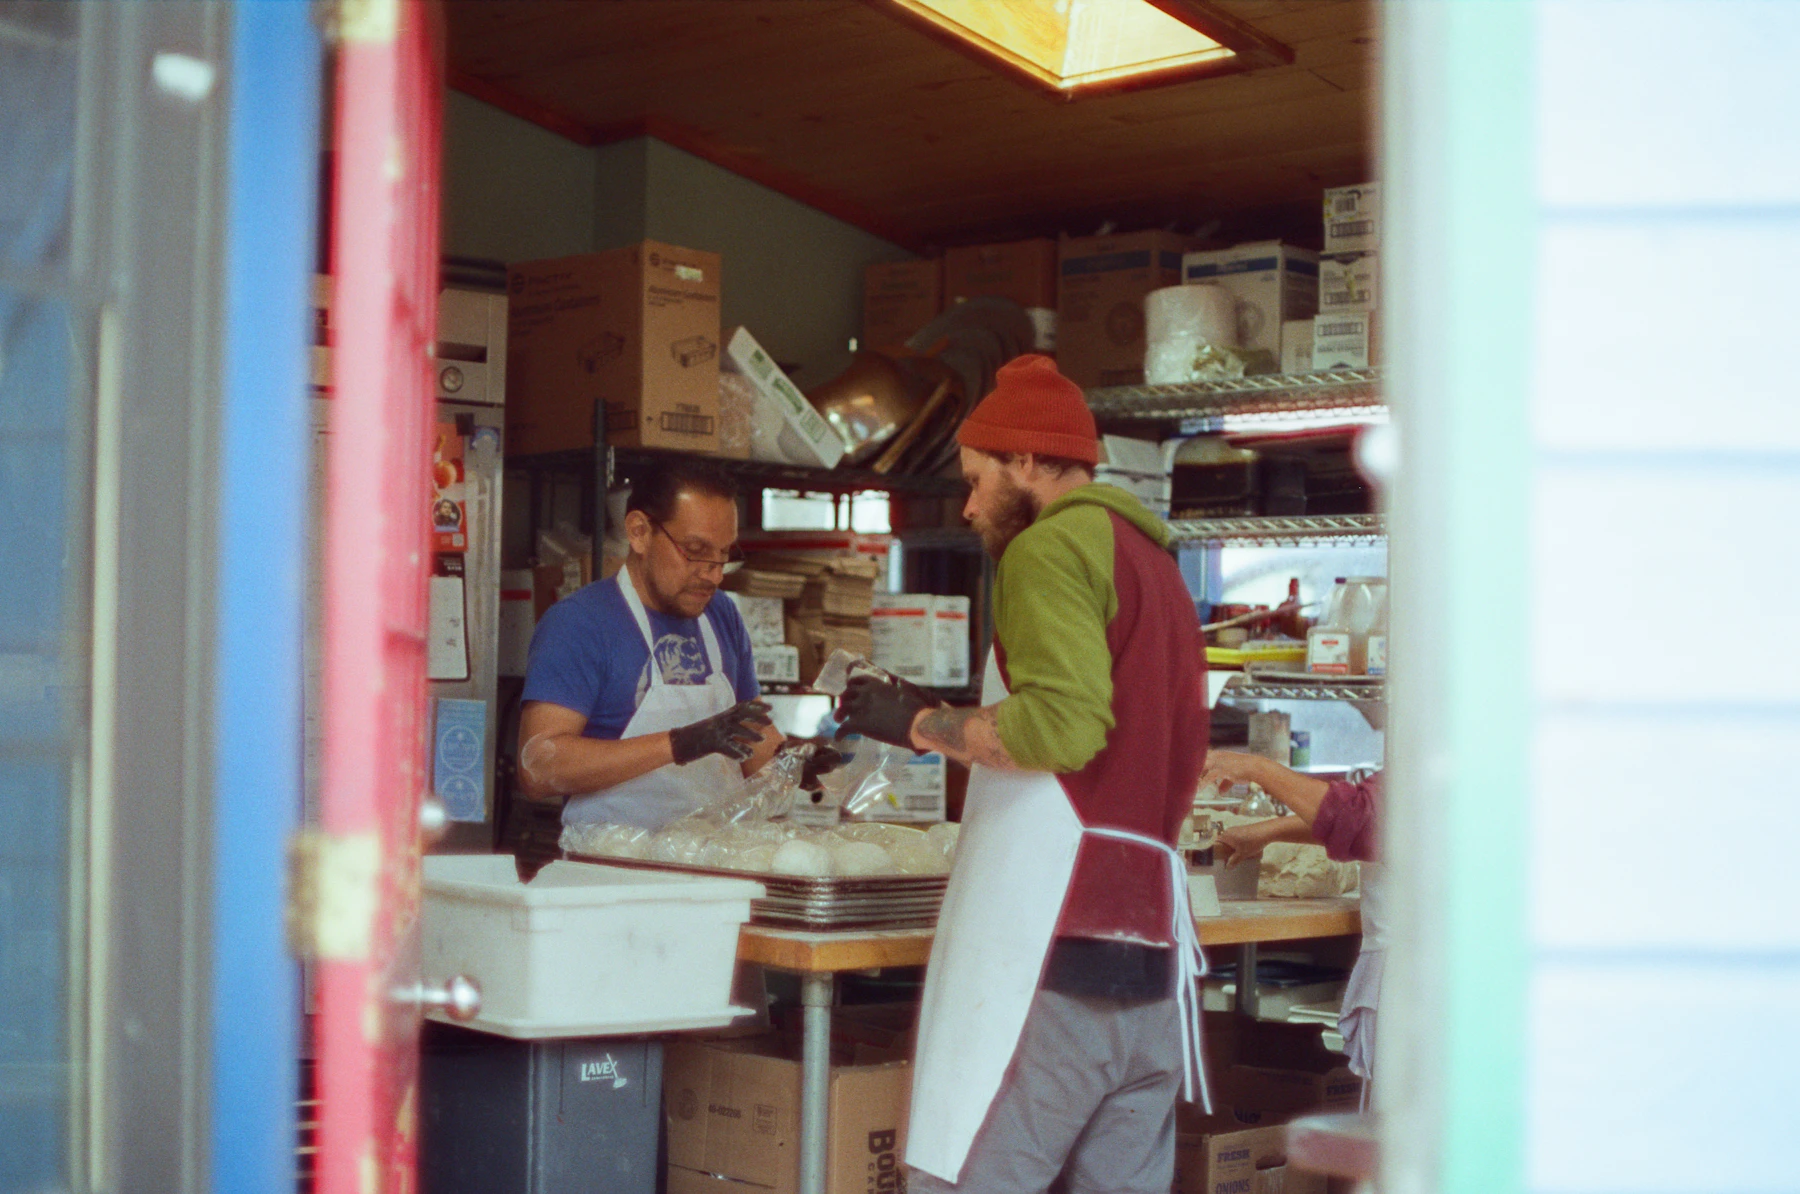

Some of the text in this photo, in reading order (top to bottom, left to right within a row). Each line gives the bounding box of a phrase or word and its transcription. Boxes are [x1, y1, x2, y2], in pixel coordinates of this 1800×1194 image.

[581, 1053, 619, 1082] LAVEX
[868, 1129, 897, 1194] BOU
[1217, 1149, 1251, 1163] FRESH
[1216, 1178, 1251, 1194] ONIONS
